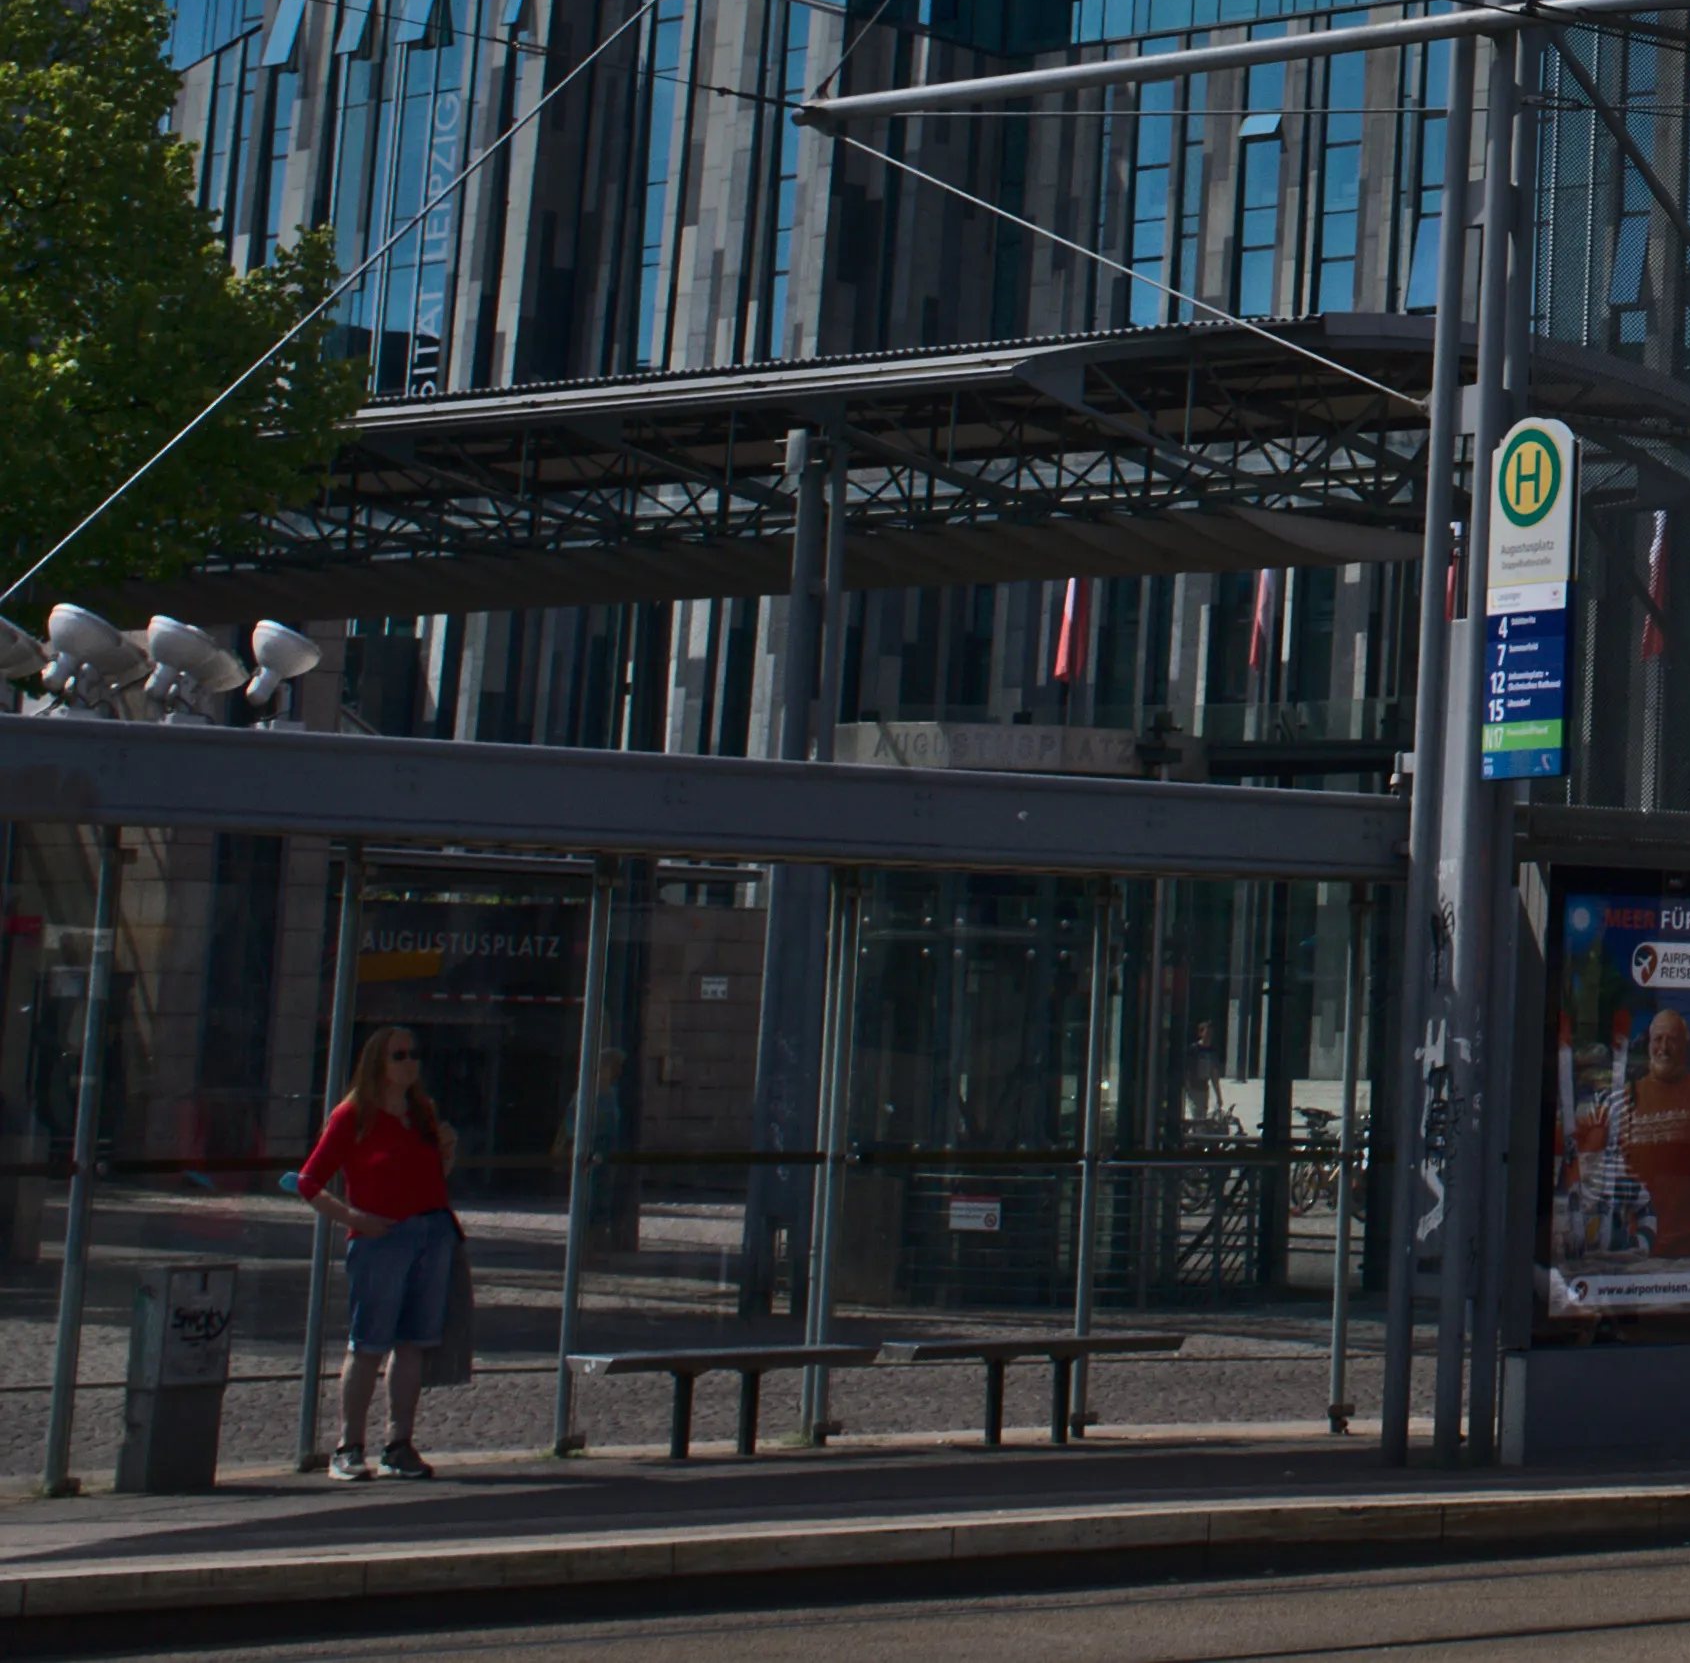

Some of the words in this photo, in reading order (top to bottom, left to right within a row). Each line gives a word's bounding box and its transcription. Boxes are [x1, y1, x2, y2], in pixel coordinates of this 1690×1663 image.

[1514, 449, 1542, 506] H
[1497, 615, 1508, 639] 4
[1496, 643, 1507, 667] 7
[1489, 670, 1506, 694] 12
[1488, 698, 1505, 722] 15
[1604, 908, 1656, 930] MEER
[361, 930, 562, 959] AUGUSTUSPLATZ
